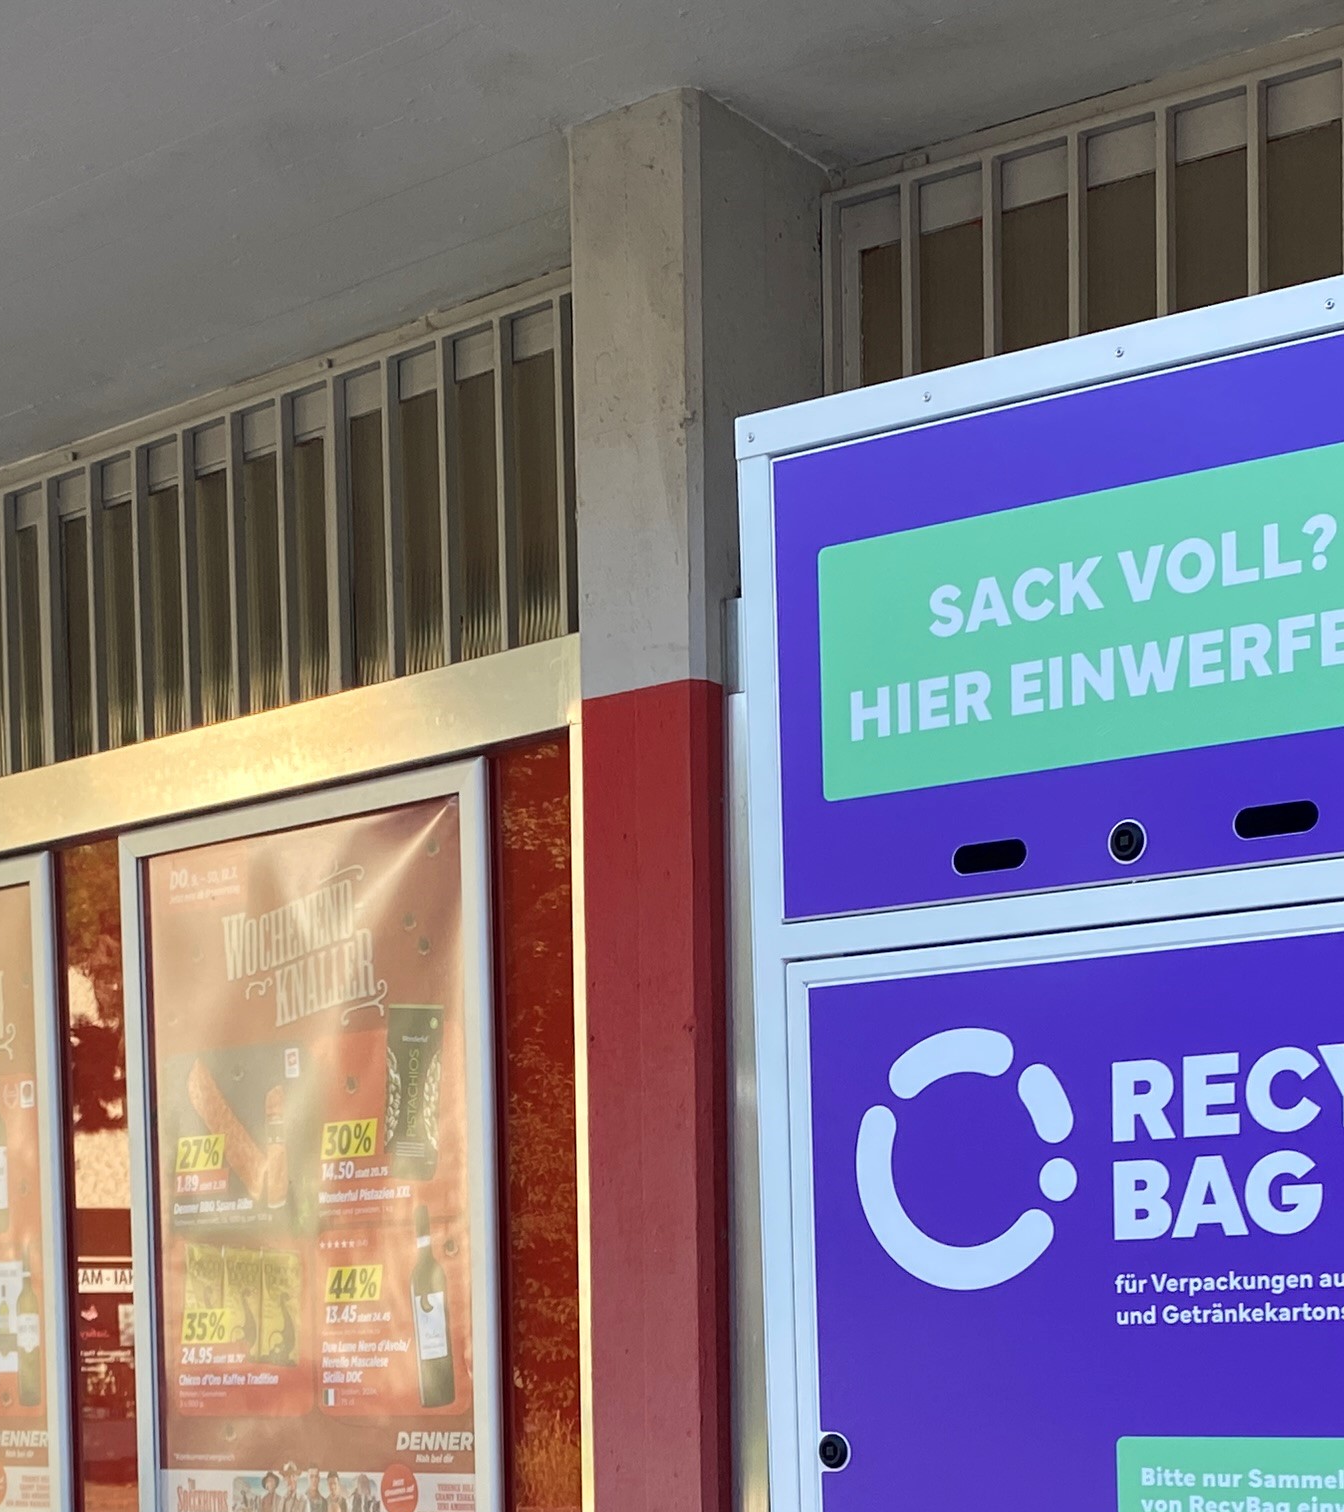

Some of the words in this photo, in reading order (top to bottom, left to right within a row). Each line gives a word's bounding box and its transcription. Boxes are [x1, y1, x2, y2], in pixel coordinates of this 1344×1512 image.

[928, 555, 1104, 638] SACK
[1117, 512, 1338, 603] VOLL?
[850, 671, 992, 741] HIER
[275, 928, 376, 1028] KNALLER
[406, 1048, 419, 1137] PISTACHIOS
[180, 1137, 219, 1169] 27%
[325, 1121, 371, 1156] 30%
[177, 1174, 199, 1193] 1.89
[322, 1161, 354, 1180] 14.50
[1113, 1150, 1323, 1241] BAG
[329, 1268, 376, 1299] 44%
[1115, 1274, 1147, 1295] für
[1151, 1270, 1313, 1296] Verpackungen
[184, 1312, 225, 1341] 35%
[326, 1306, 357, 1324] 13.45
[1116, 1304, 1156, 1326] und
[181, 1348, 213, 1364] 24.95
[396, 1432, 473, 1451] DENNER
[1141, 1467, 1196, 1487] Bitte
[1203, 1472, 1242, 1487] nur
